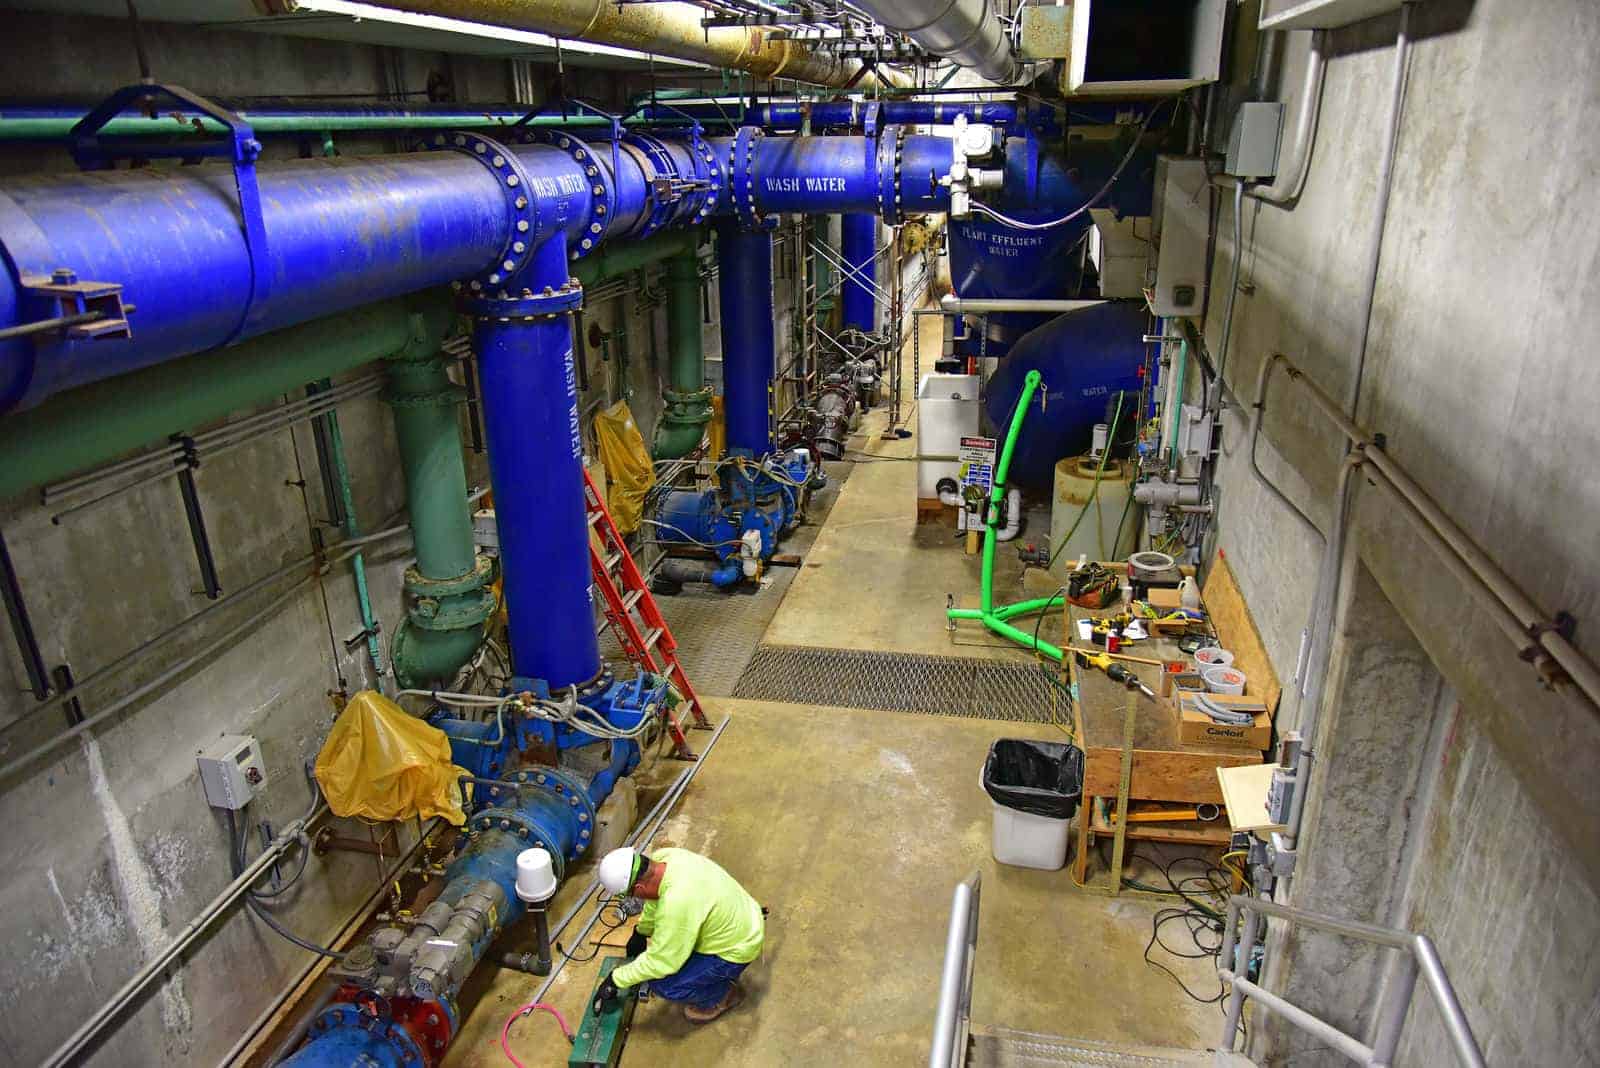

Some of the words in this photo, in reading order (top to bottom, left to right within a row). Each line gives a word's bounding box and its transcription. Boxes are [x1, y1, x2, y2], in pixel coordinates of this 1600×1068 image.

[531, 176, 559, 200] WASH
[556, 174, 586, 196] WATER
[765, 177, 800, 192] WASH
[805, 177, 847, 192] WATER
[992, 234, 1044, 247] EFFLUENT
[564, 348, 577, 397] WASH
